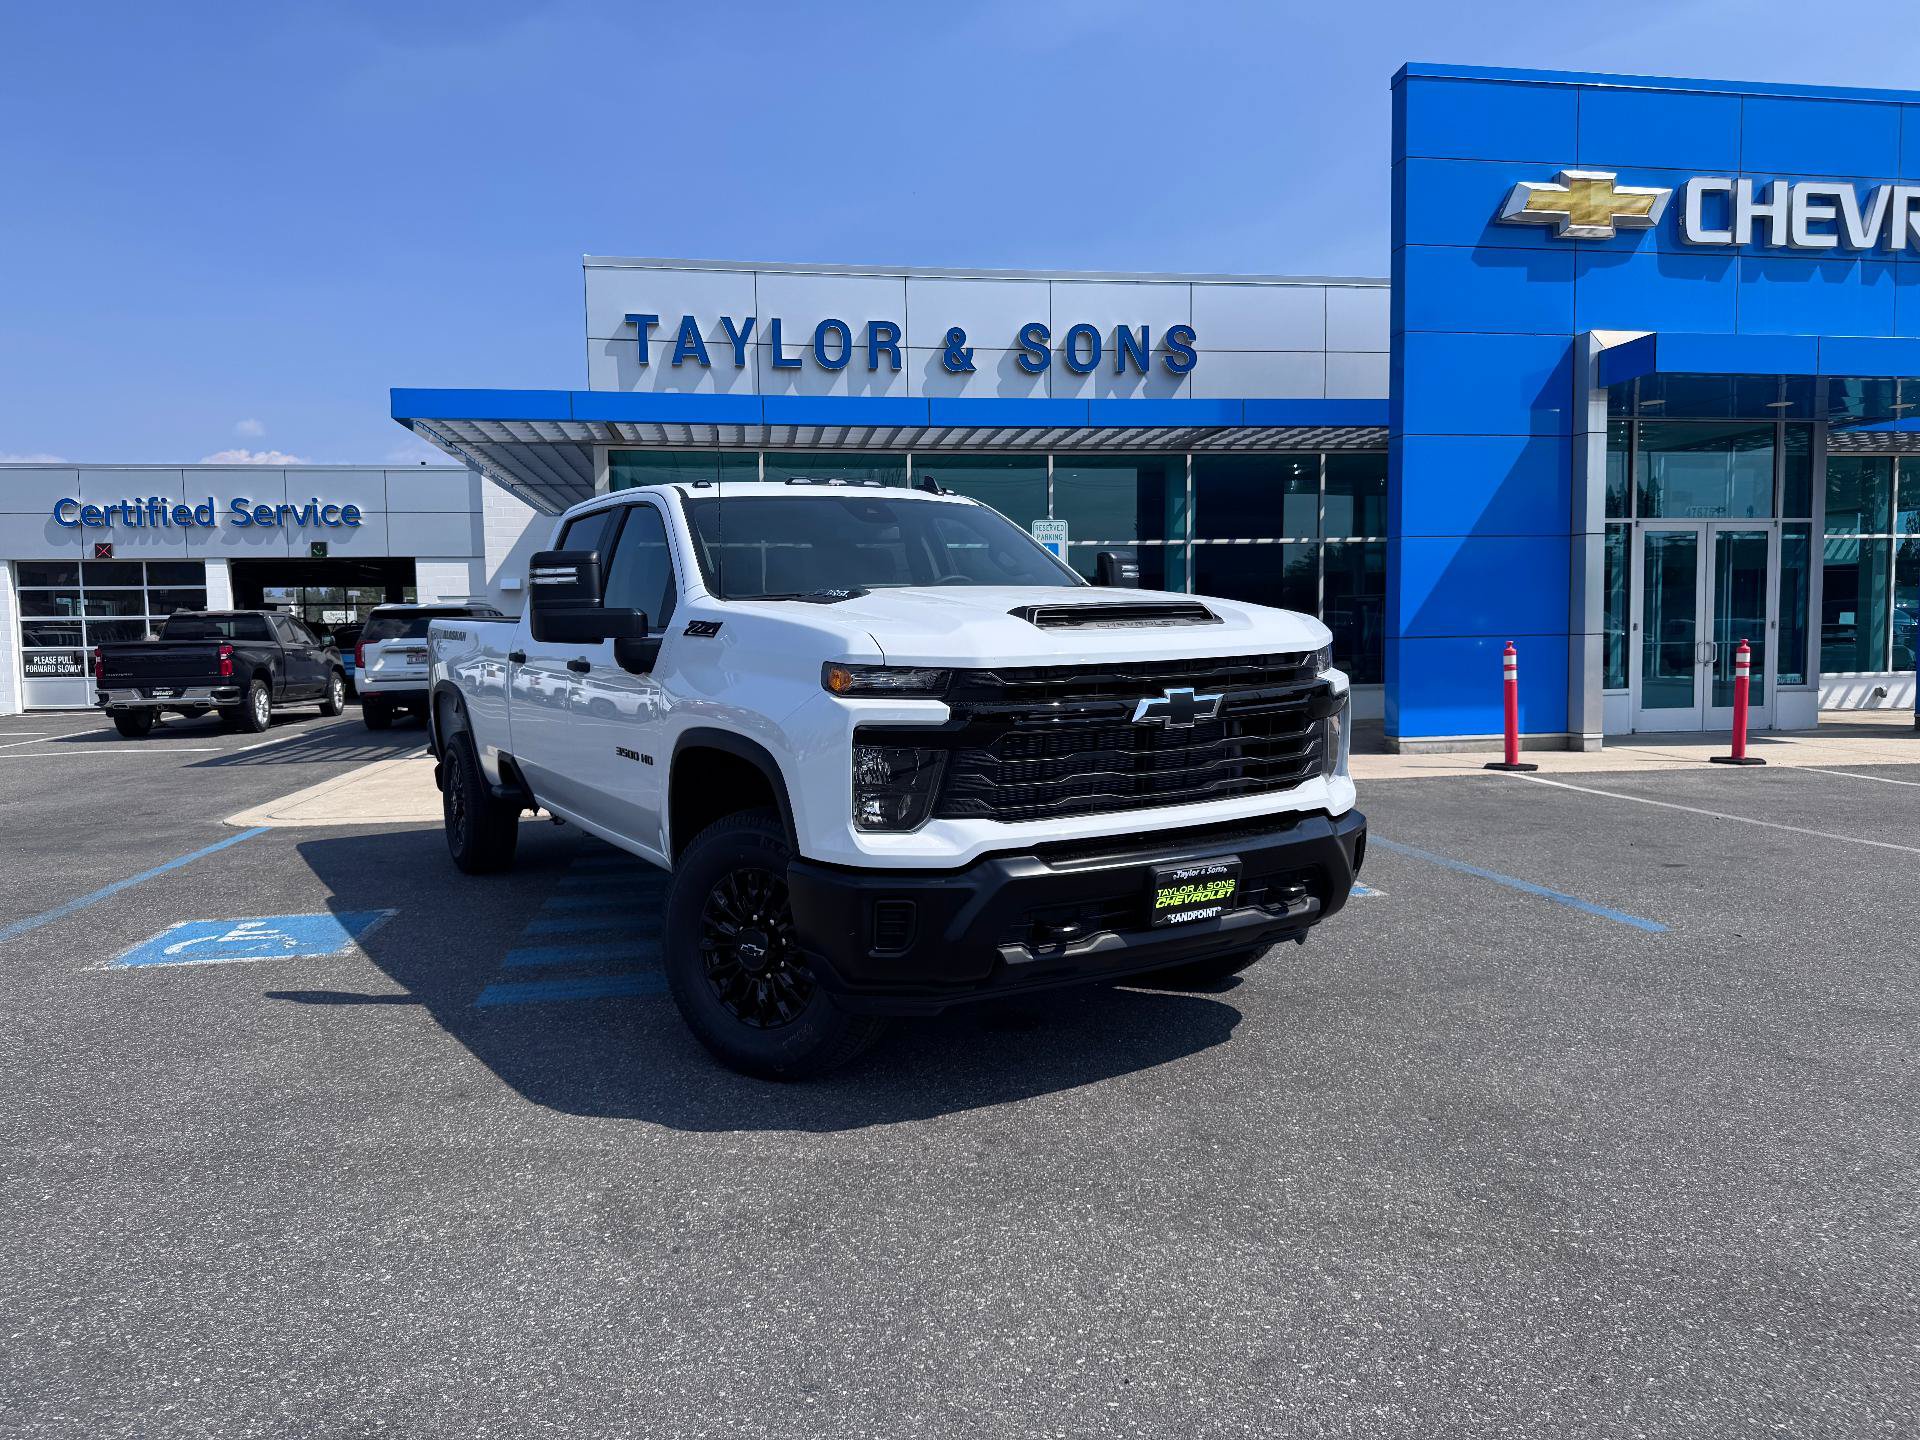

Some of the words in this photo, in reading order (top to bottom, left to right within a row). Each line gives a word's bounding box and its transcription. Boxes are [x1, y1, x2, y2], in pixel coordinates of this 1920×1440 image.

[624, 313, 902, 371] TAYLOR
[942, 326, 976, 374] &
[1018, 322, 1198, 375] SONS
[53, 496, 216, 528] Certified
[230, 496, 362, 528] Service
[1035, 524, 1065, 532] RESERVED
[1036, 533, 1063, 541] PARKING
[33, 655, 56, 664] PLEASE
[57, 655, 73, 664] PULL
[25, 664, 56, 673] FORWARD
[57, 664, 82, 673] SLOWLY
[616, 746, 639, 761] 3500
[641, 753, 653, 766] HD
[1176, 868, 1200, 880] Taylor
[1206, 866, 1225, 875] Sons
[1157, 884, 1195, 898] TAYLOR
[1197, 883, 1204, 893] &
[1206, 879, 1236, 890] SONS
[1155, 888, 1234, 909] CHEVROLET
